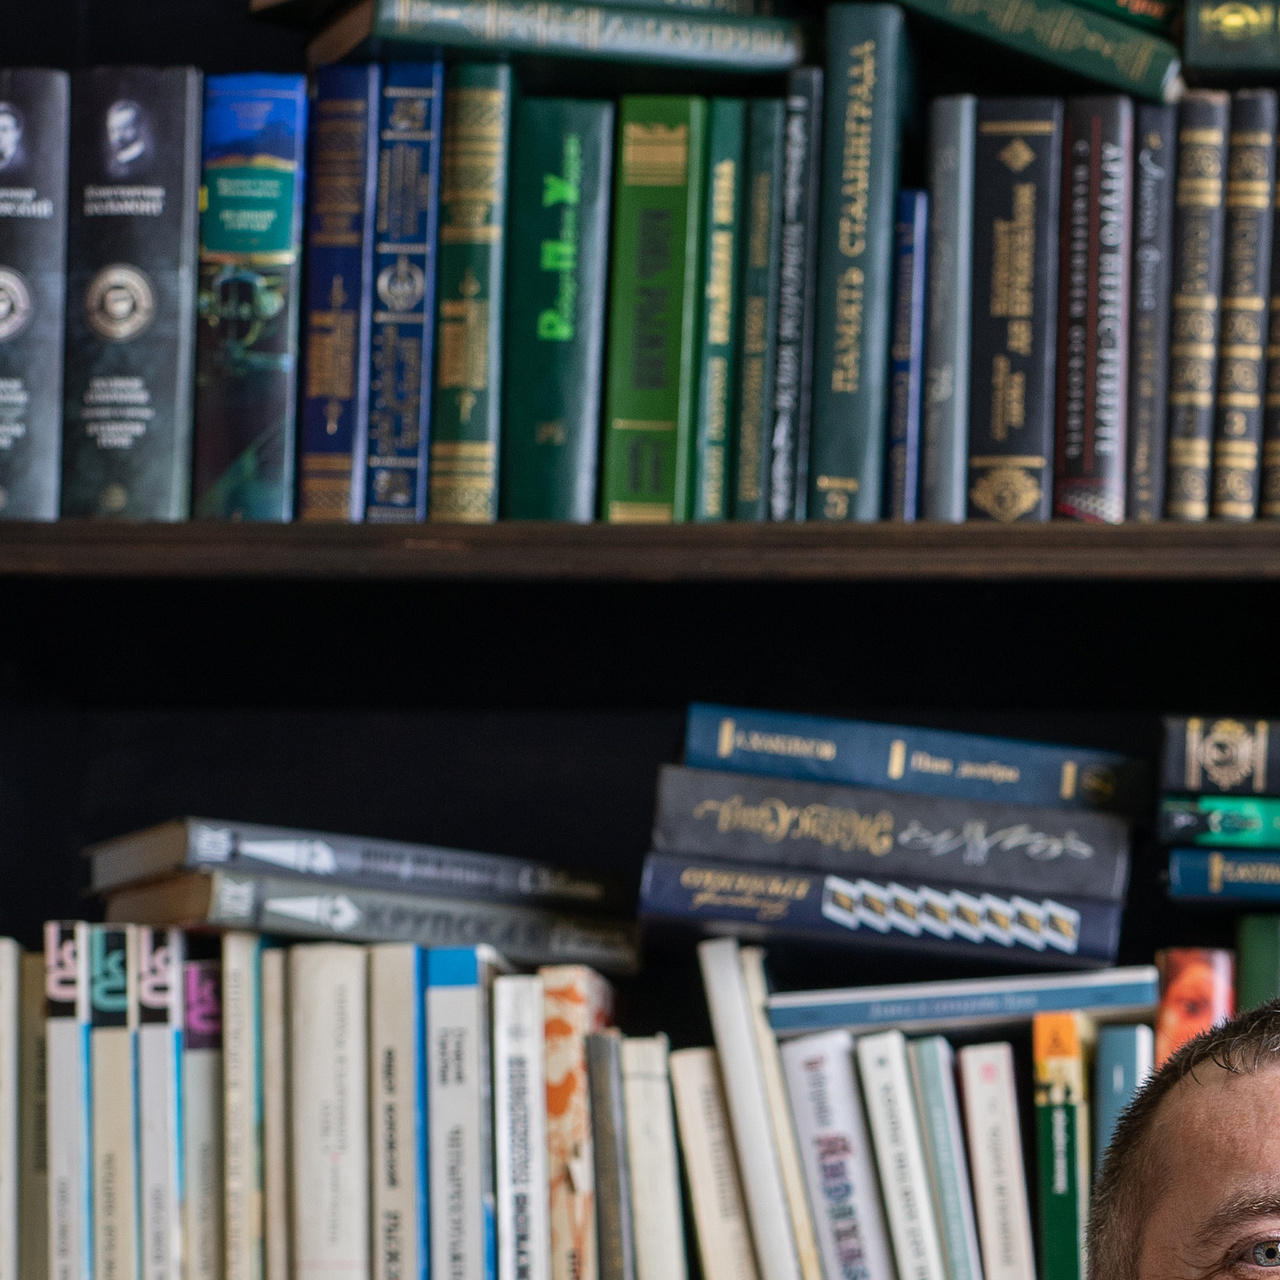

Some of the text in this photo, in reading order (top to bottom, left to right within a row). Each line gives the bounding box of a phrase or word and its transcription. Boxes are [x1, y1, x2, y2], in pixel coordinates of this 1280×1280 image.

[831, 40, 876, 393] ПАМЯТЬ СТАЛИНГРАДА
[1094, 141, 1124, 456] АРТУРО ПЕРЕС-РЕВЕРТЕ
